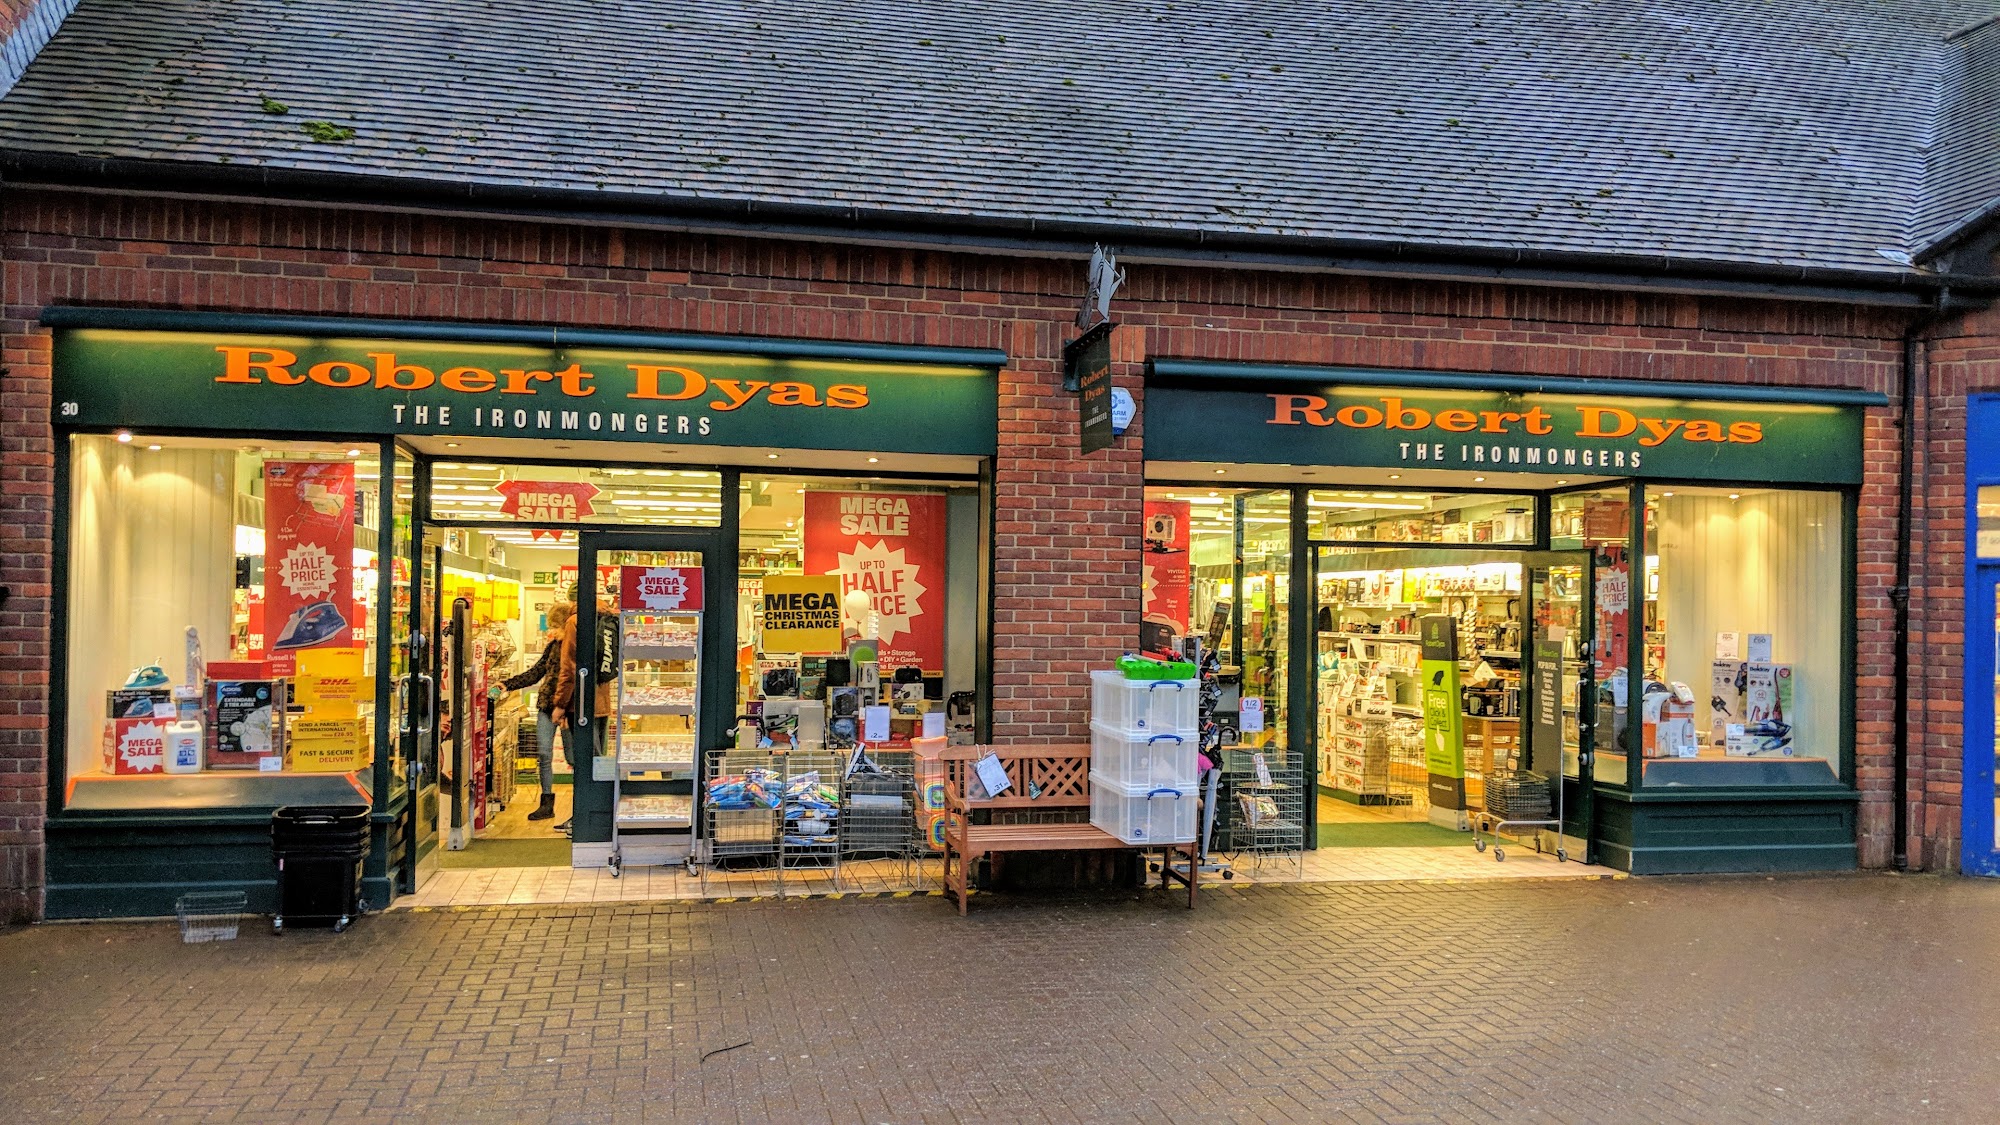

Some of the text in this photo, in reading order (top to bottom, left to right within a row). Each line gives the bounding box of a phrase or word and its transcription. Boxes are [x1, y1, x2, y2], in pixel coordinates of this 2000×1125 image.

[214, 346, 870, 411] Robert Dyas
[61, 402, 78, 416] 30
[393, 404, 712, 437] THE IRONMONGERS
[1265, 393, 1764, 448] Robert Dyas
[1400, 442, 1642, 469] THE IRONMONGERS
[518, 492, 577, 507] MEGA
[840, 497, 911, 516] MEGA
[517, 507, 577, 521] SALE
[840, 515, 910, 536] SALE
[289, 556, 325, 571] HALF
[860, 560, 886, 570] UP TO
[291, 570, 326, 583] PRICE
[644, 576, 680, 586] MEGA
[842, 569, 905, 596] HALF
[644, 585, 680, 596] SALE
[1602, 581, 1627, 593] HALF
[764, 593, 839, 611] MEGA
[1603, 592, 1627, 604] PRICE
[844, 594, 907, 619] ICE
[764, 610, 840, 621] CHRISTMAS
[765, 619, 840, 630] CLEARANCE
[266, 653, 289, 661] Russell
[1245, 699, 1258, 707] 1/2
[1428, 693, 1447, 709] Free
[127, 738, 163, 748] MEGA
[127, 746, 163, 757] SALE
[318, 756, 355, 764] DELIVERY
